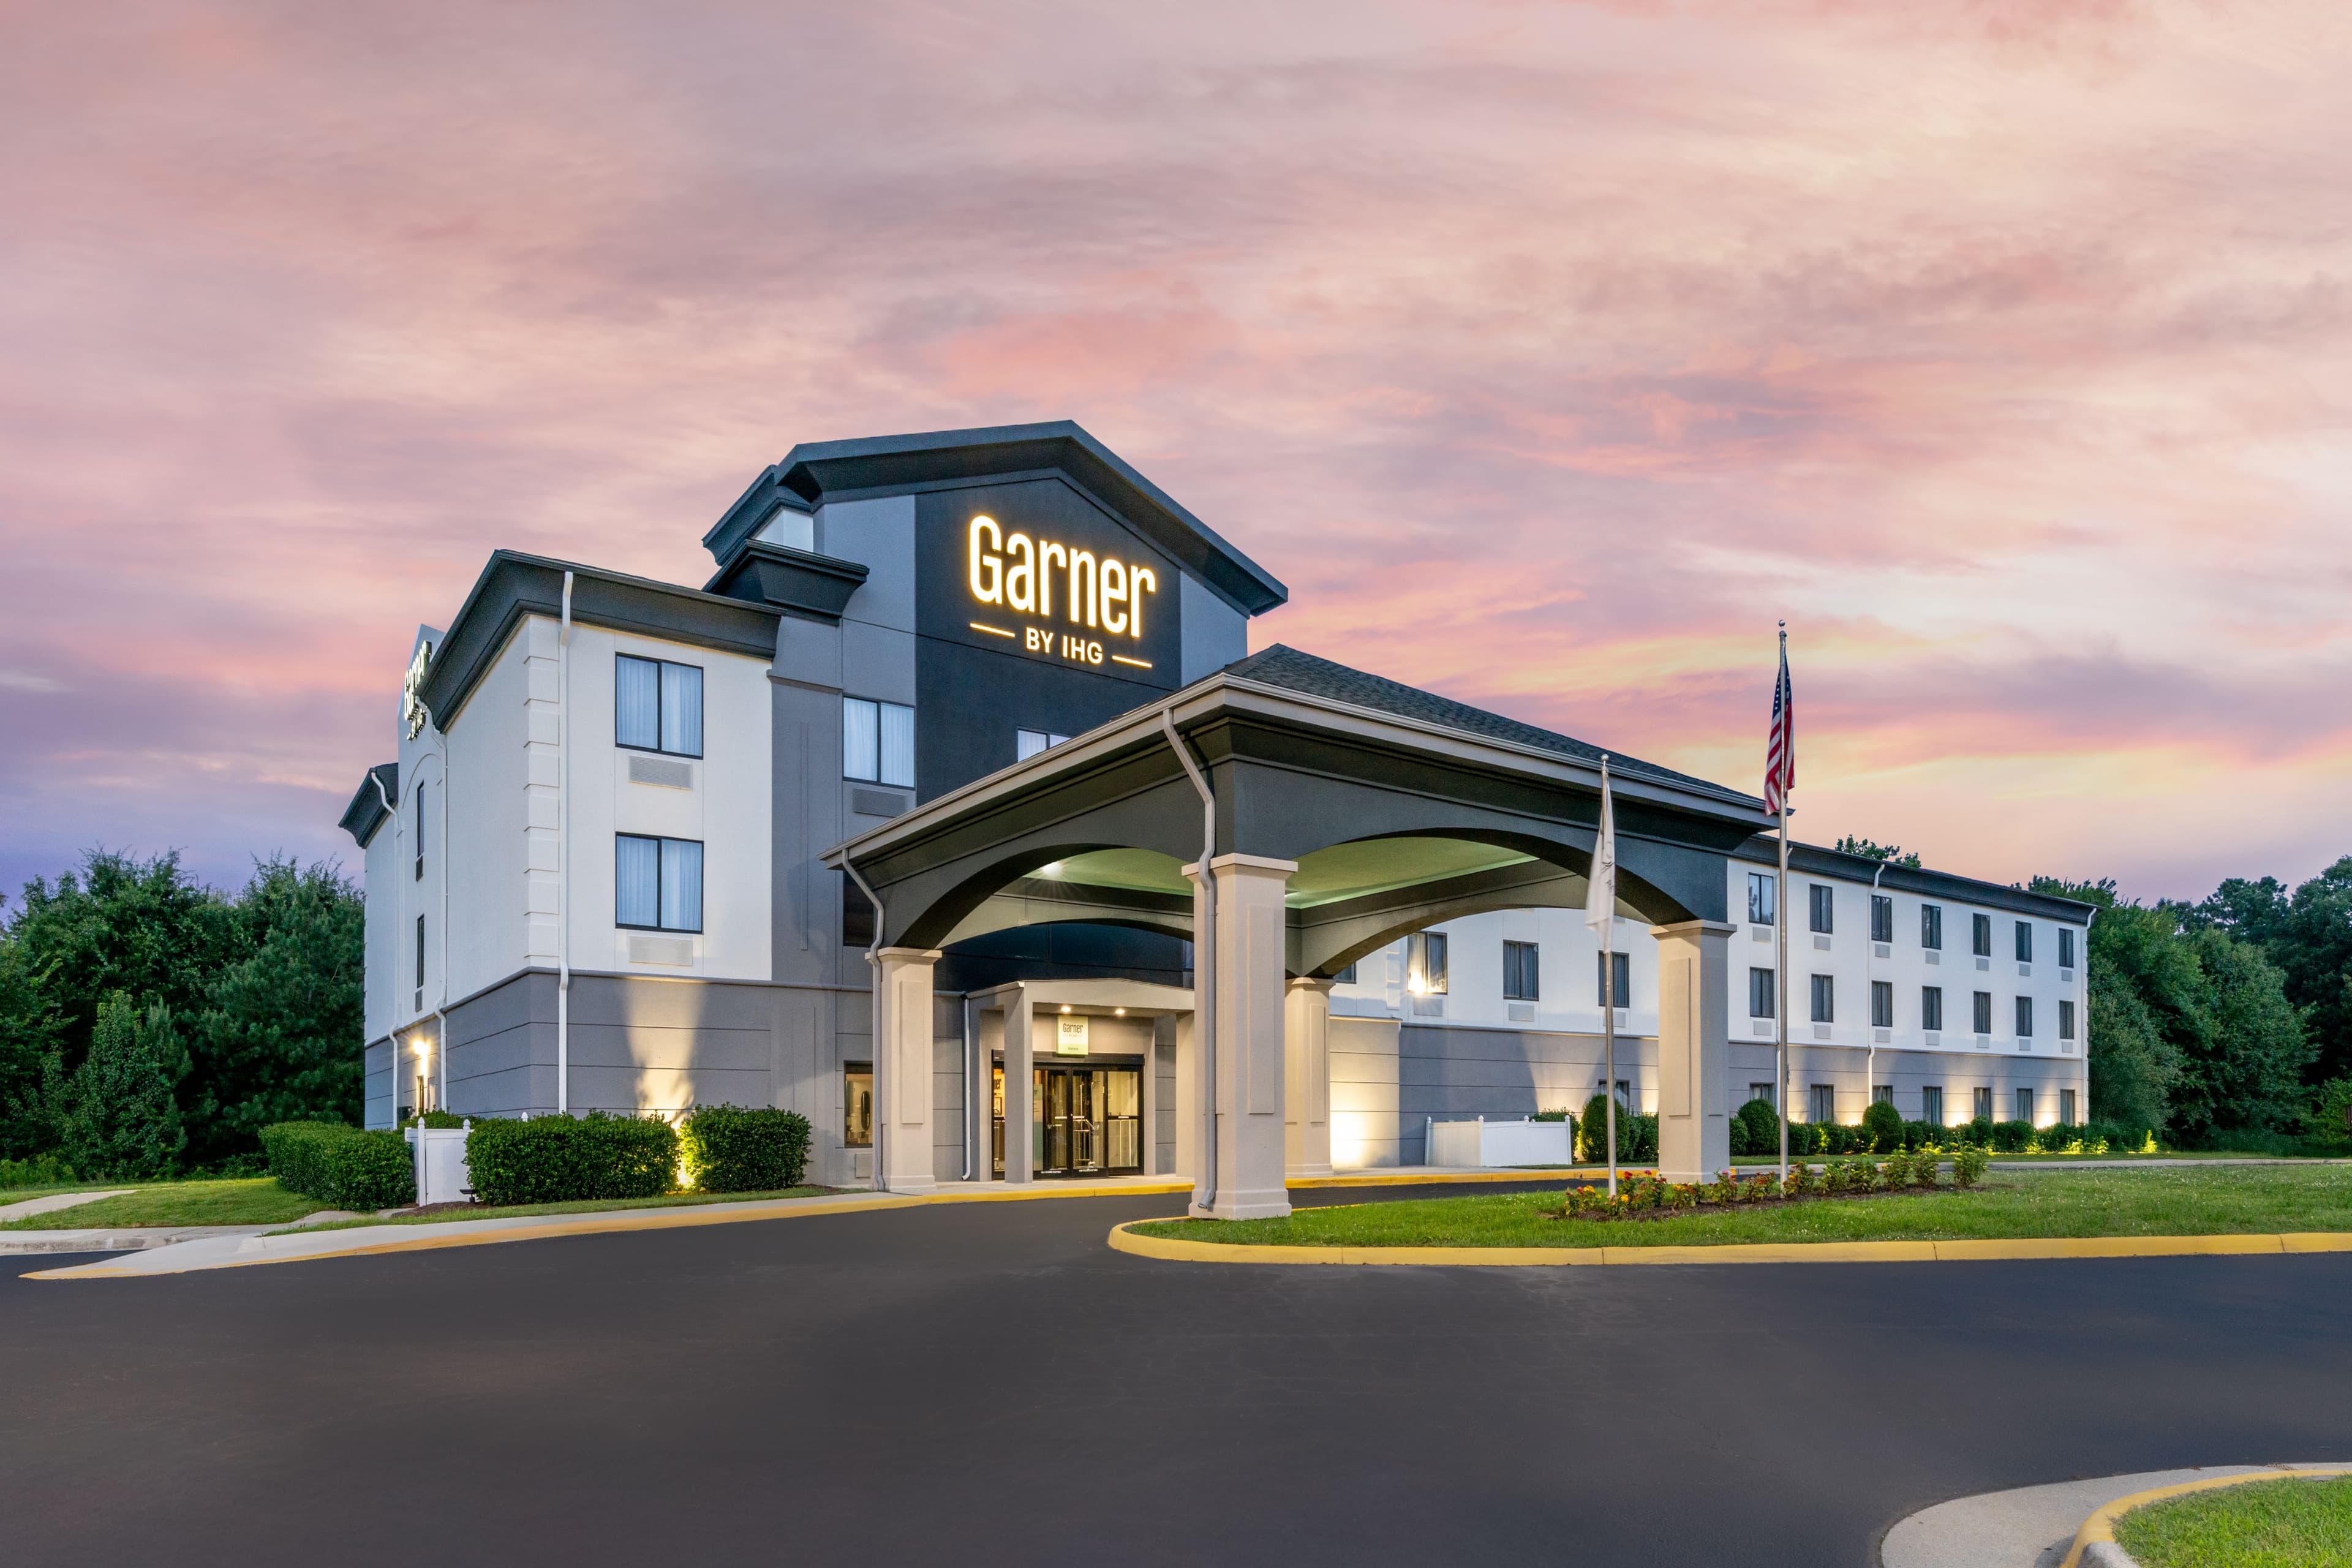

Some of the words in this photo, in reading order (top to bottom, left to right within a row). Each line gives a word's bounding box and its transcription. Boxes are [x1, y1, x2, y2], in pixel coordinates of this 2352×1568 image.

[969, 514, 1156, 638] Garner
[1026, 627, 1054, 654] BY
[1063, 635, 1102, 664] IHG
[1063, 1023, 1084, 1033] Garner
